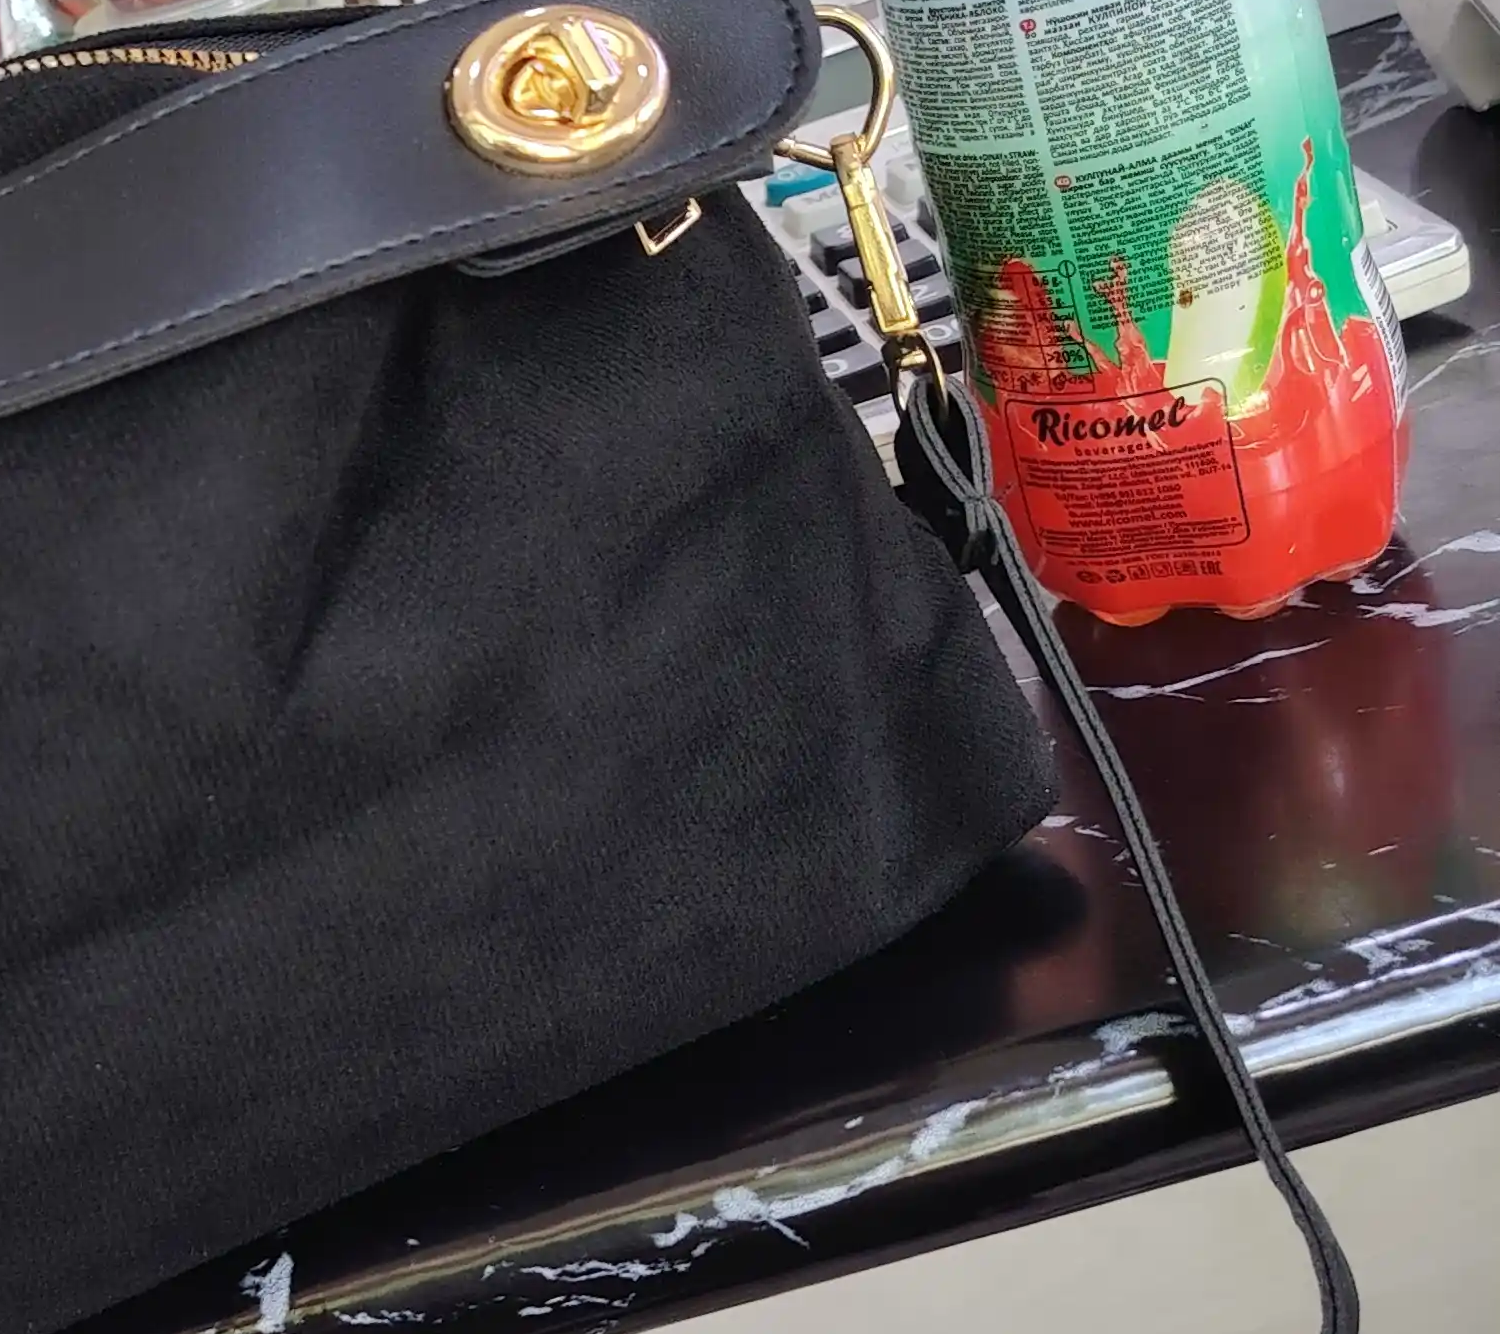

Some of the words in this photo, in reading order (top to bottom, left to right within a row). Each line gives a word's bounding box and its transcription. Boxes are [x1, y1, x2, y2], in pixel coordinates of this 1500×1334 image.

[1046, 349, 1083, 364] >20%
[1031, 395, 1187, 448] Ricomel
[1074, 440, 1152, 458] beverages
